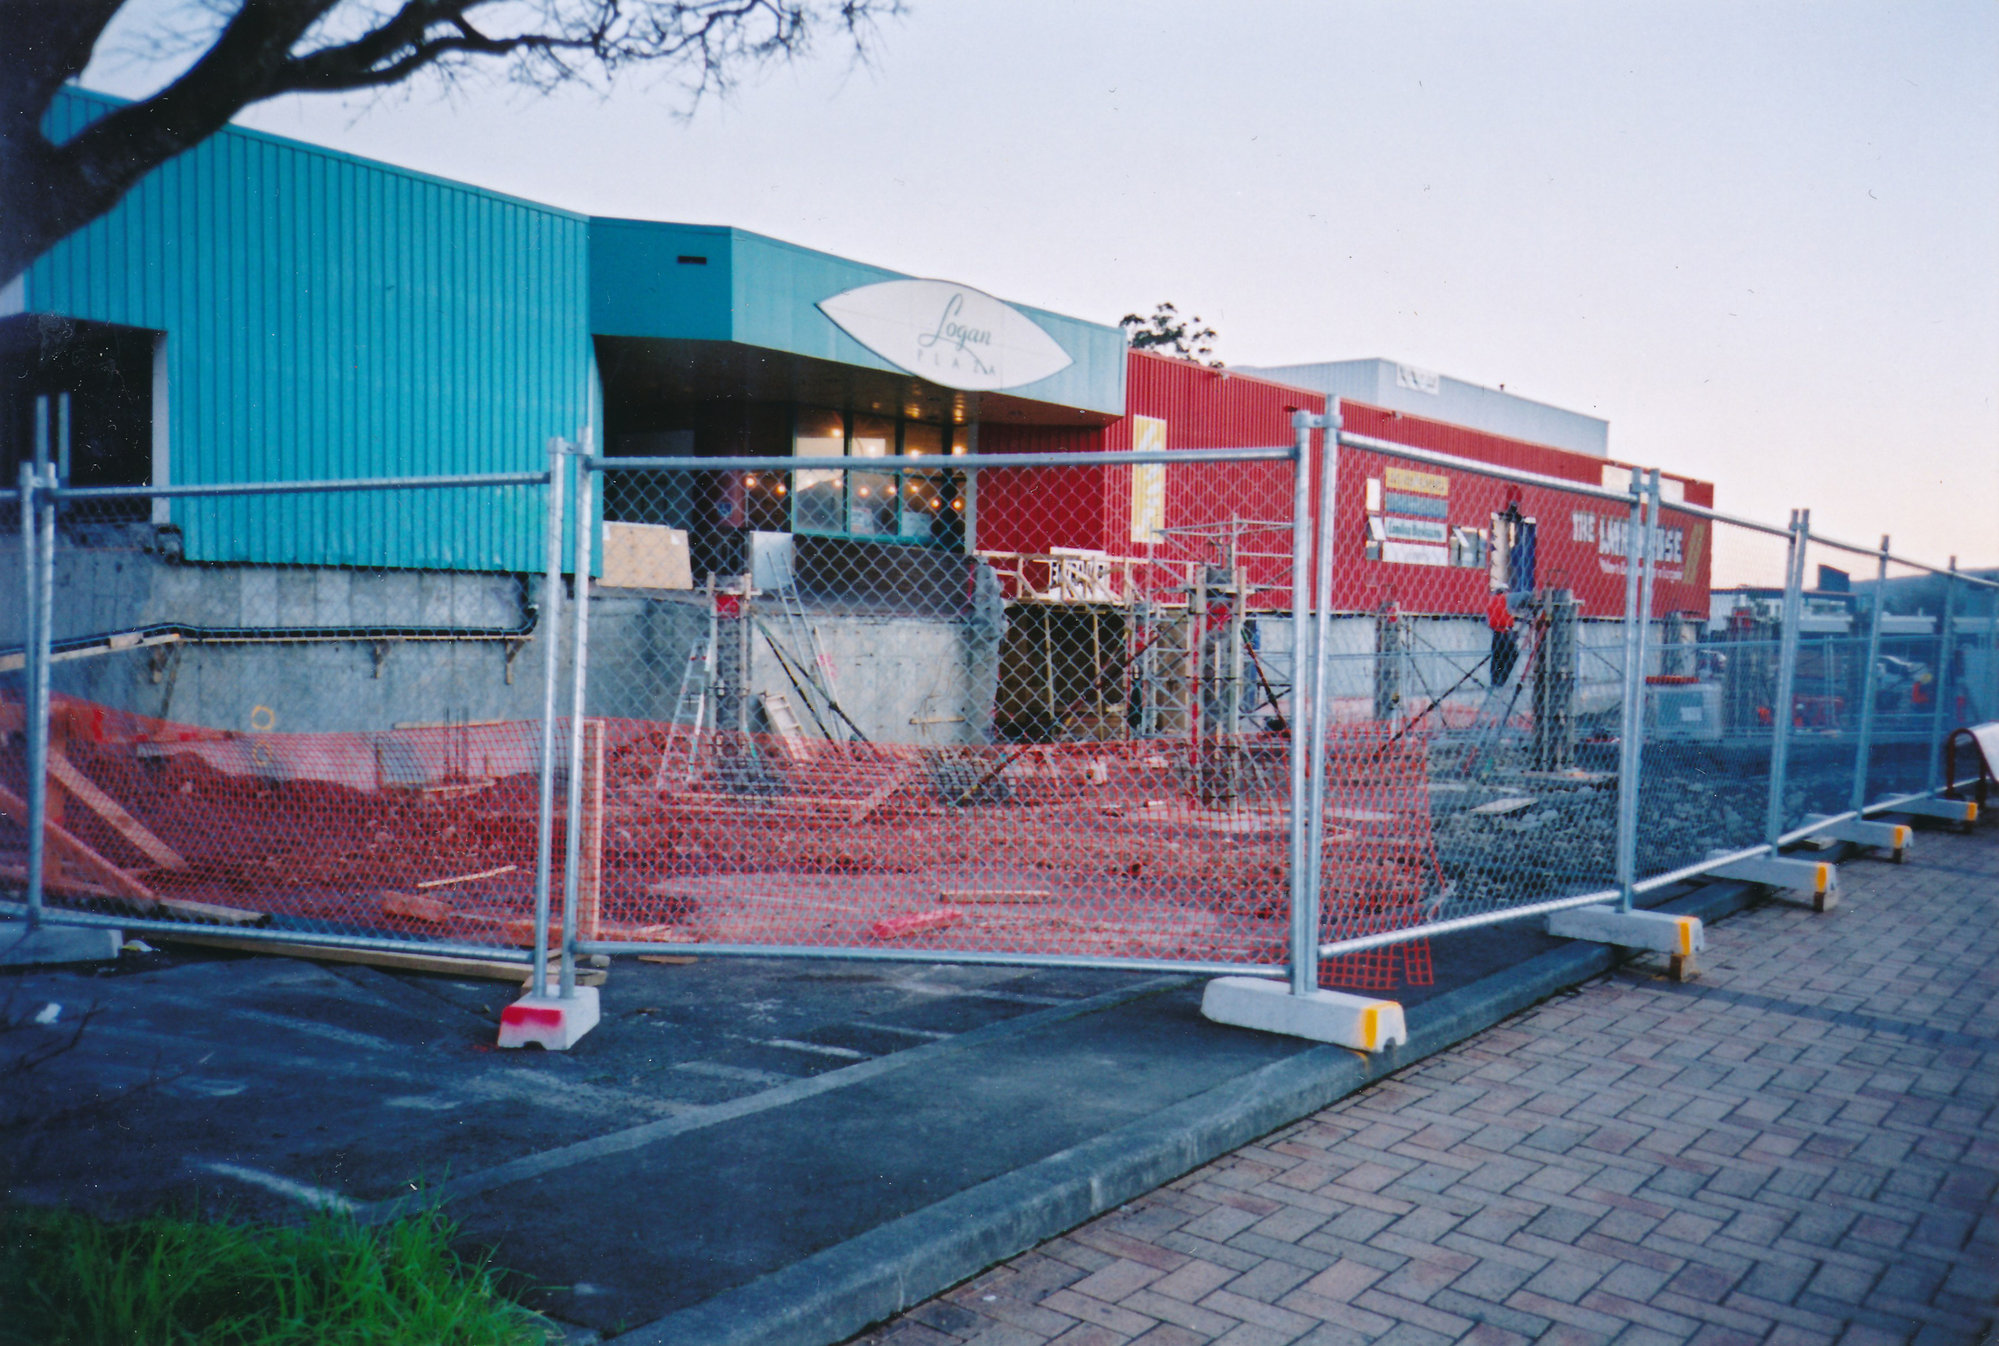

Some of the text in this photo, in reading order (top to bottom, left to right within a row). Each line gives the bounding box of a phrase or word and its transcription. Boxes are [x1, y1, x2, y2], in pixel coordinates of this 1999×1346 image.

[918, 293, 991, 351] Logan
[1572, 511, 1683, 563] THE WARUSE
